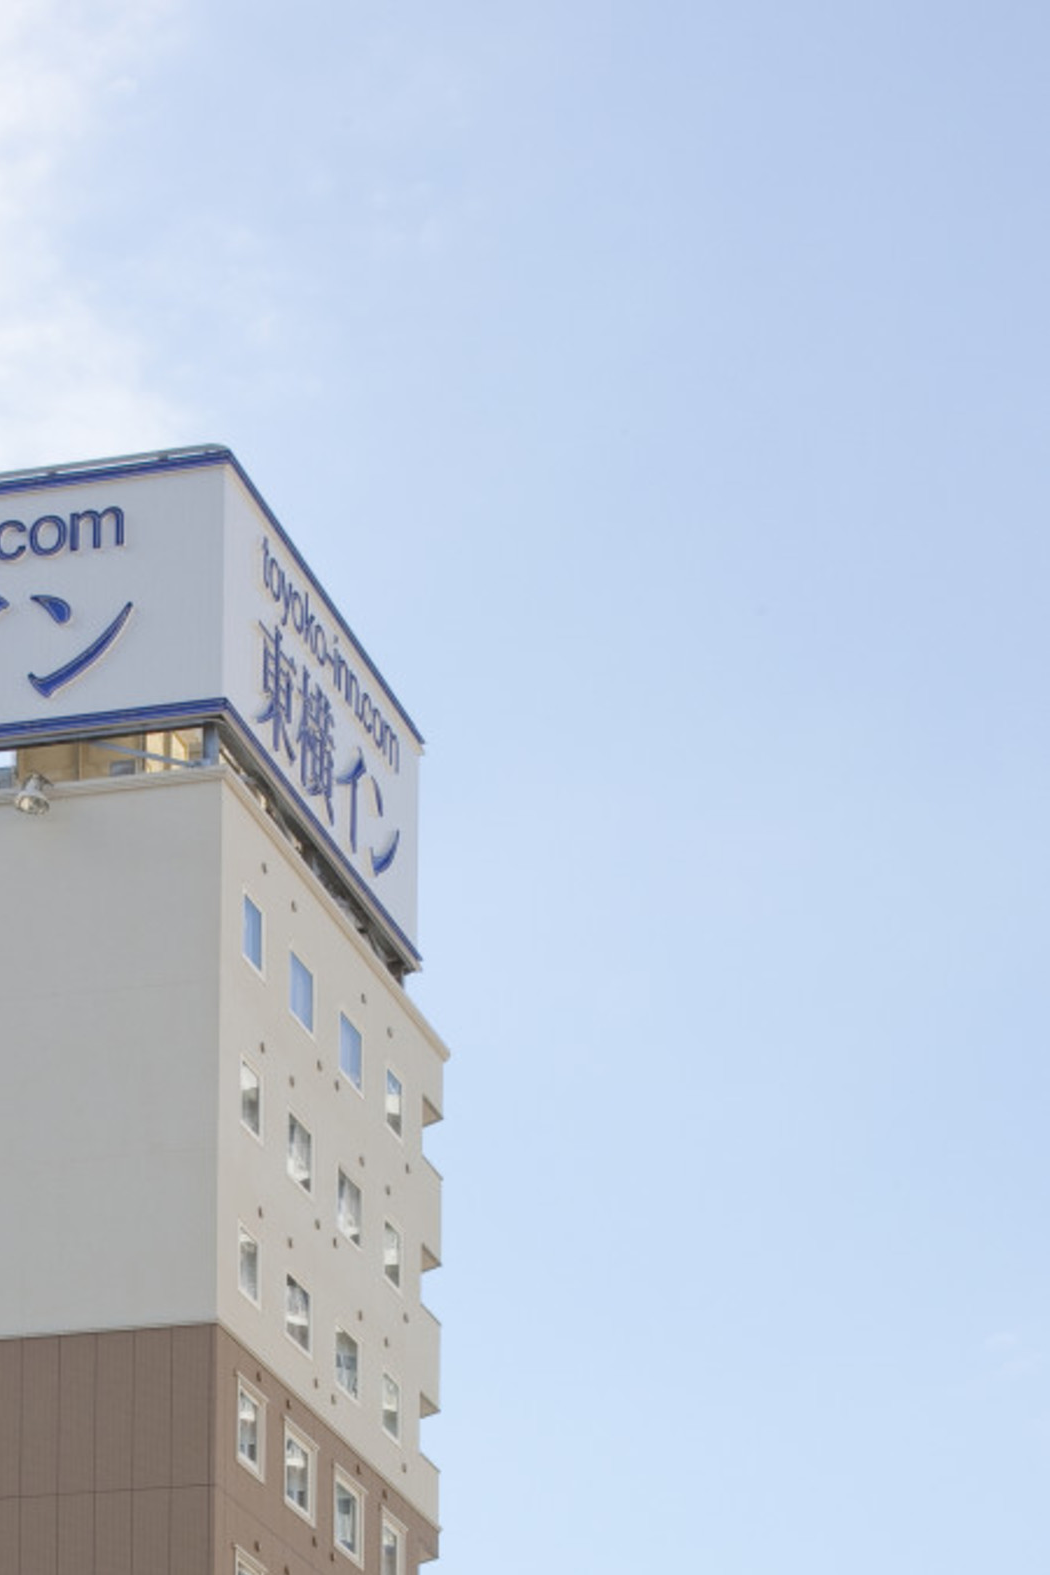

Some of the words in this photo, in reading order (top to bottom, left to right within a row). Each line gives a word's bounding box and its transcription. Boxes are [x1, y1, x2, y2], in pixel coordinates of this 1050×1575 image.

[256, 619, 400, 878] 東横イン
[261, 535, 400, 775] toyoko-inn.com
